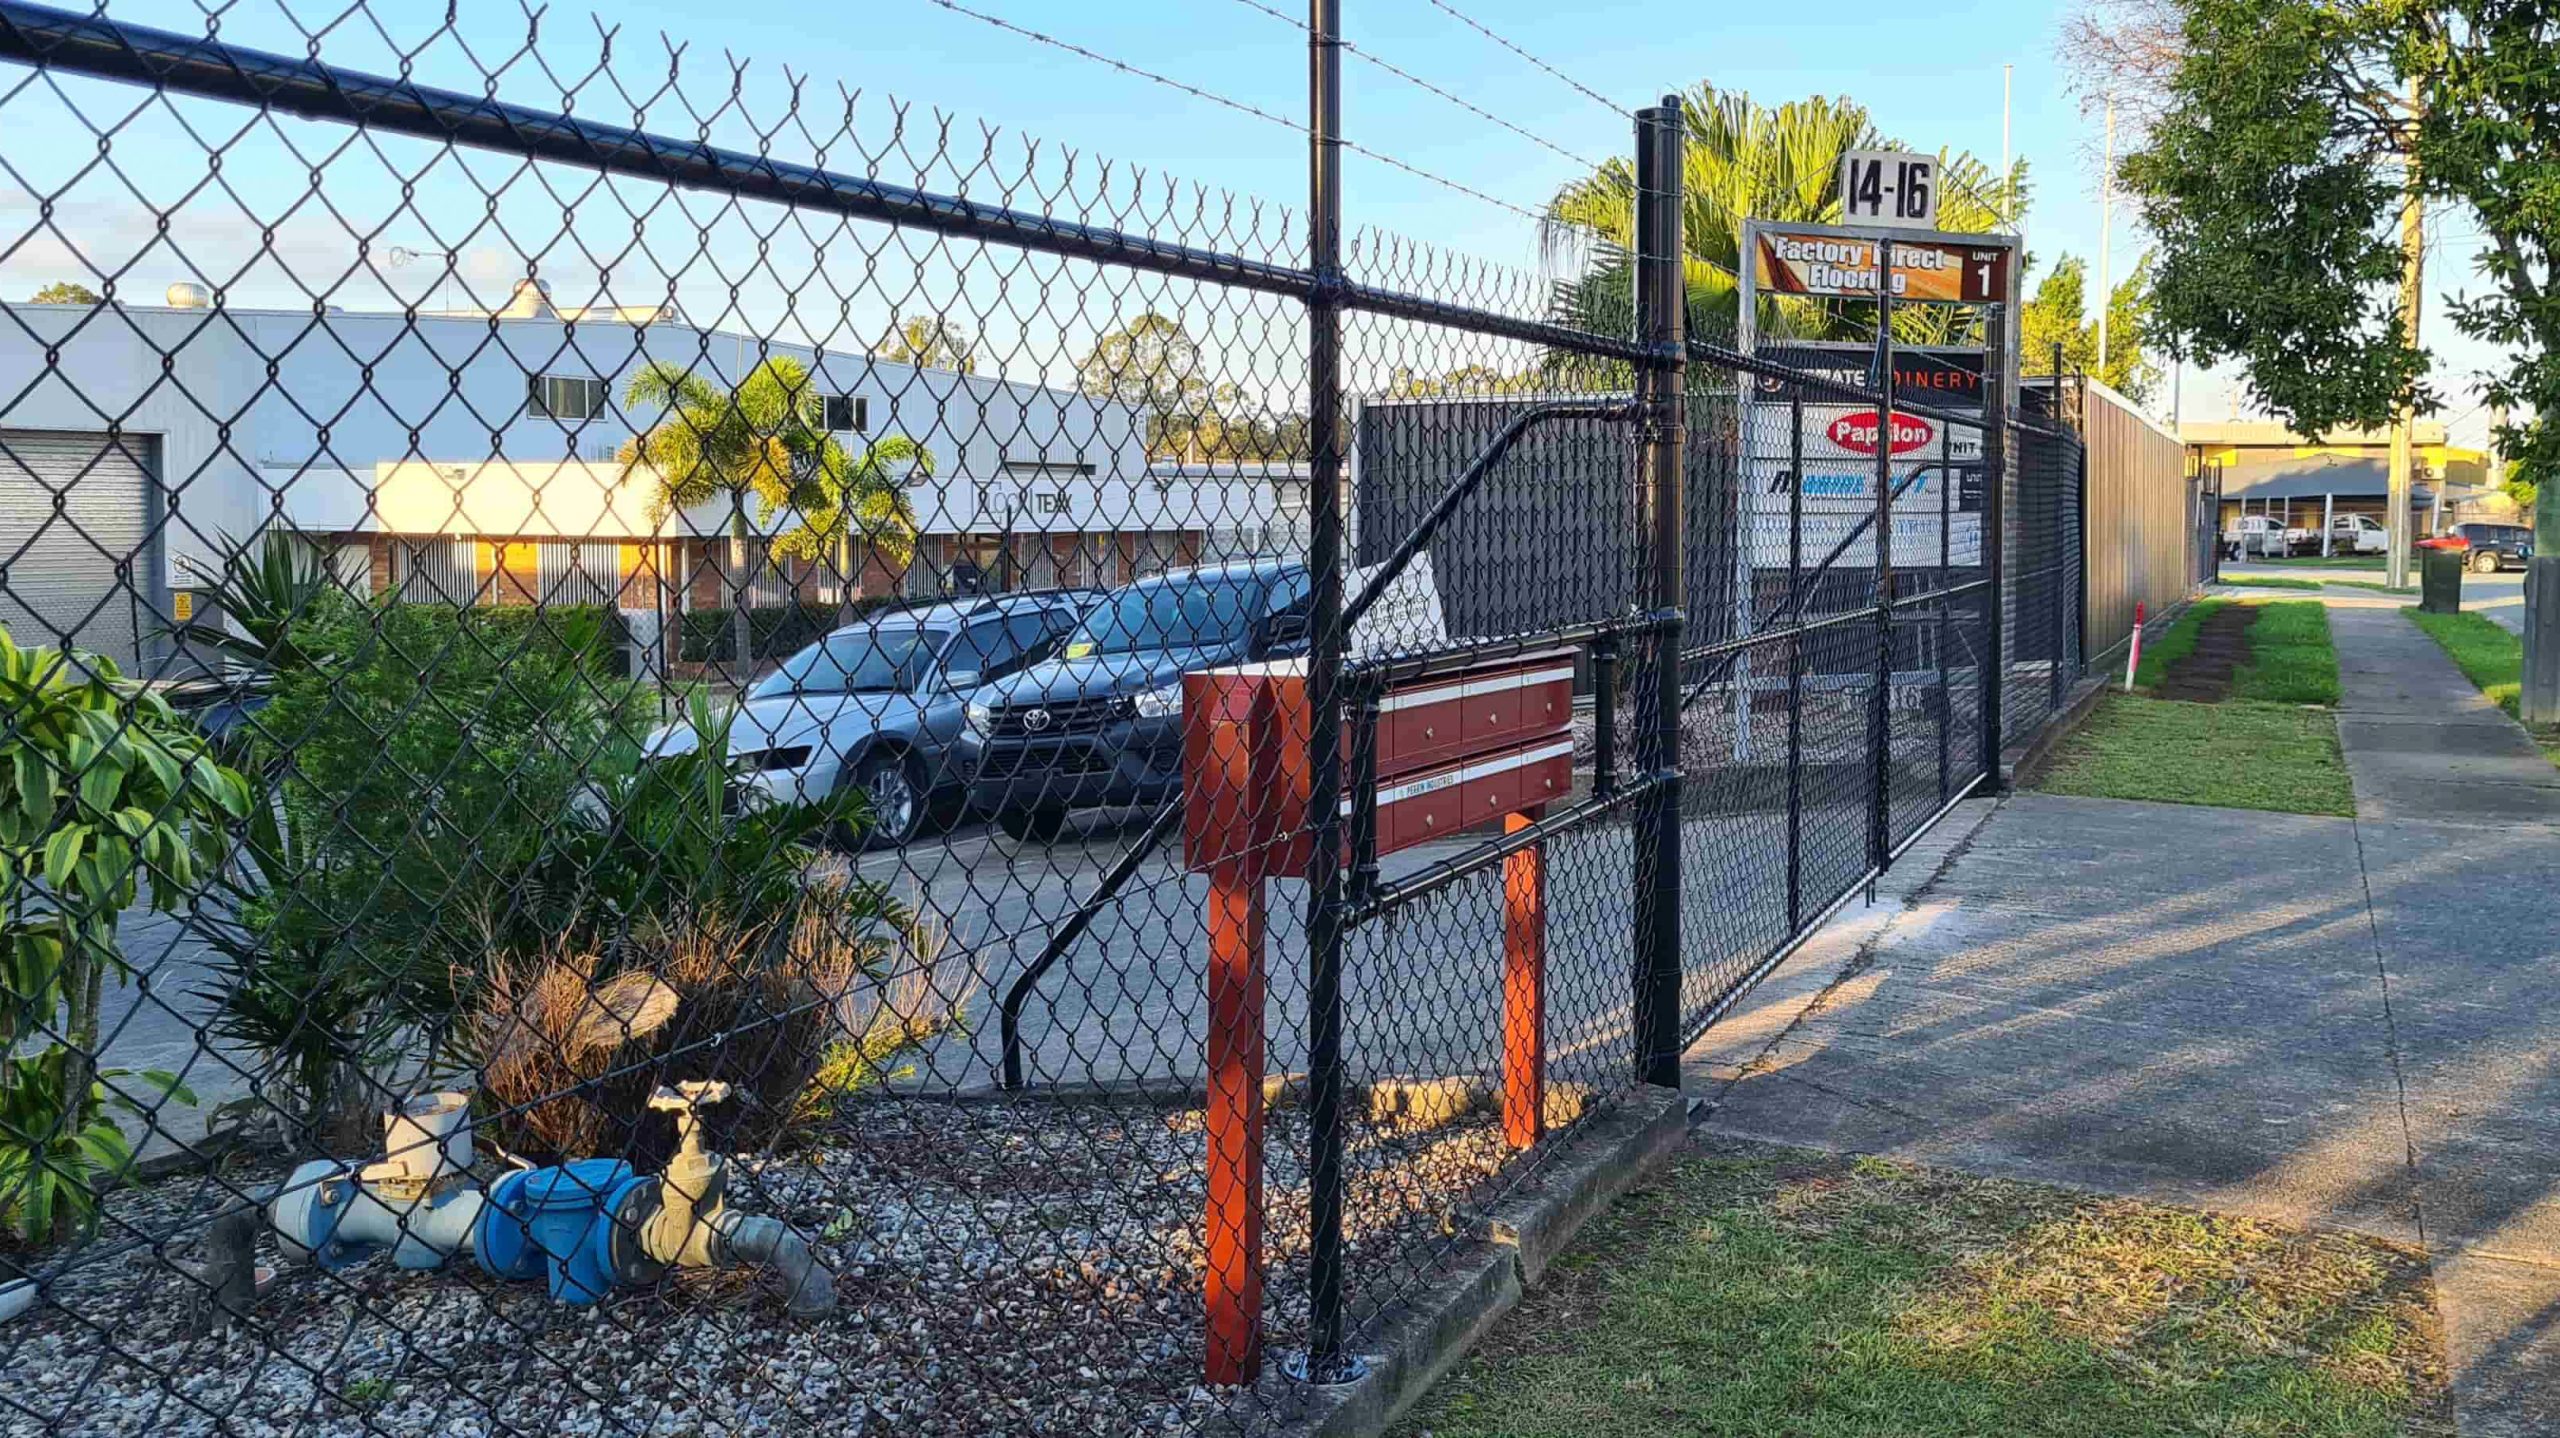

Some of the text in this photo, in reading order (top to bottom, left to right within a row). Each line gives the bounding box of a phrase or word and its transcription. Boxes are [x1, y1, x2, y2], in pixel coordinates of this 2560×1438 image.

[1849, 158, 1929, 218] 14-16
[1775, 237, 1863, 265] Factory
[1972, 251, 1998, 262] UNIT
[1809, 265, 1906, 294] Floorig
[1977, 264, 1990, 297] 1
[1836, 421, 1927, 447] Paplon
